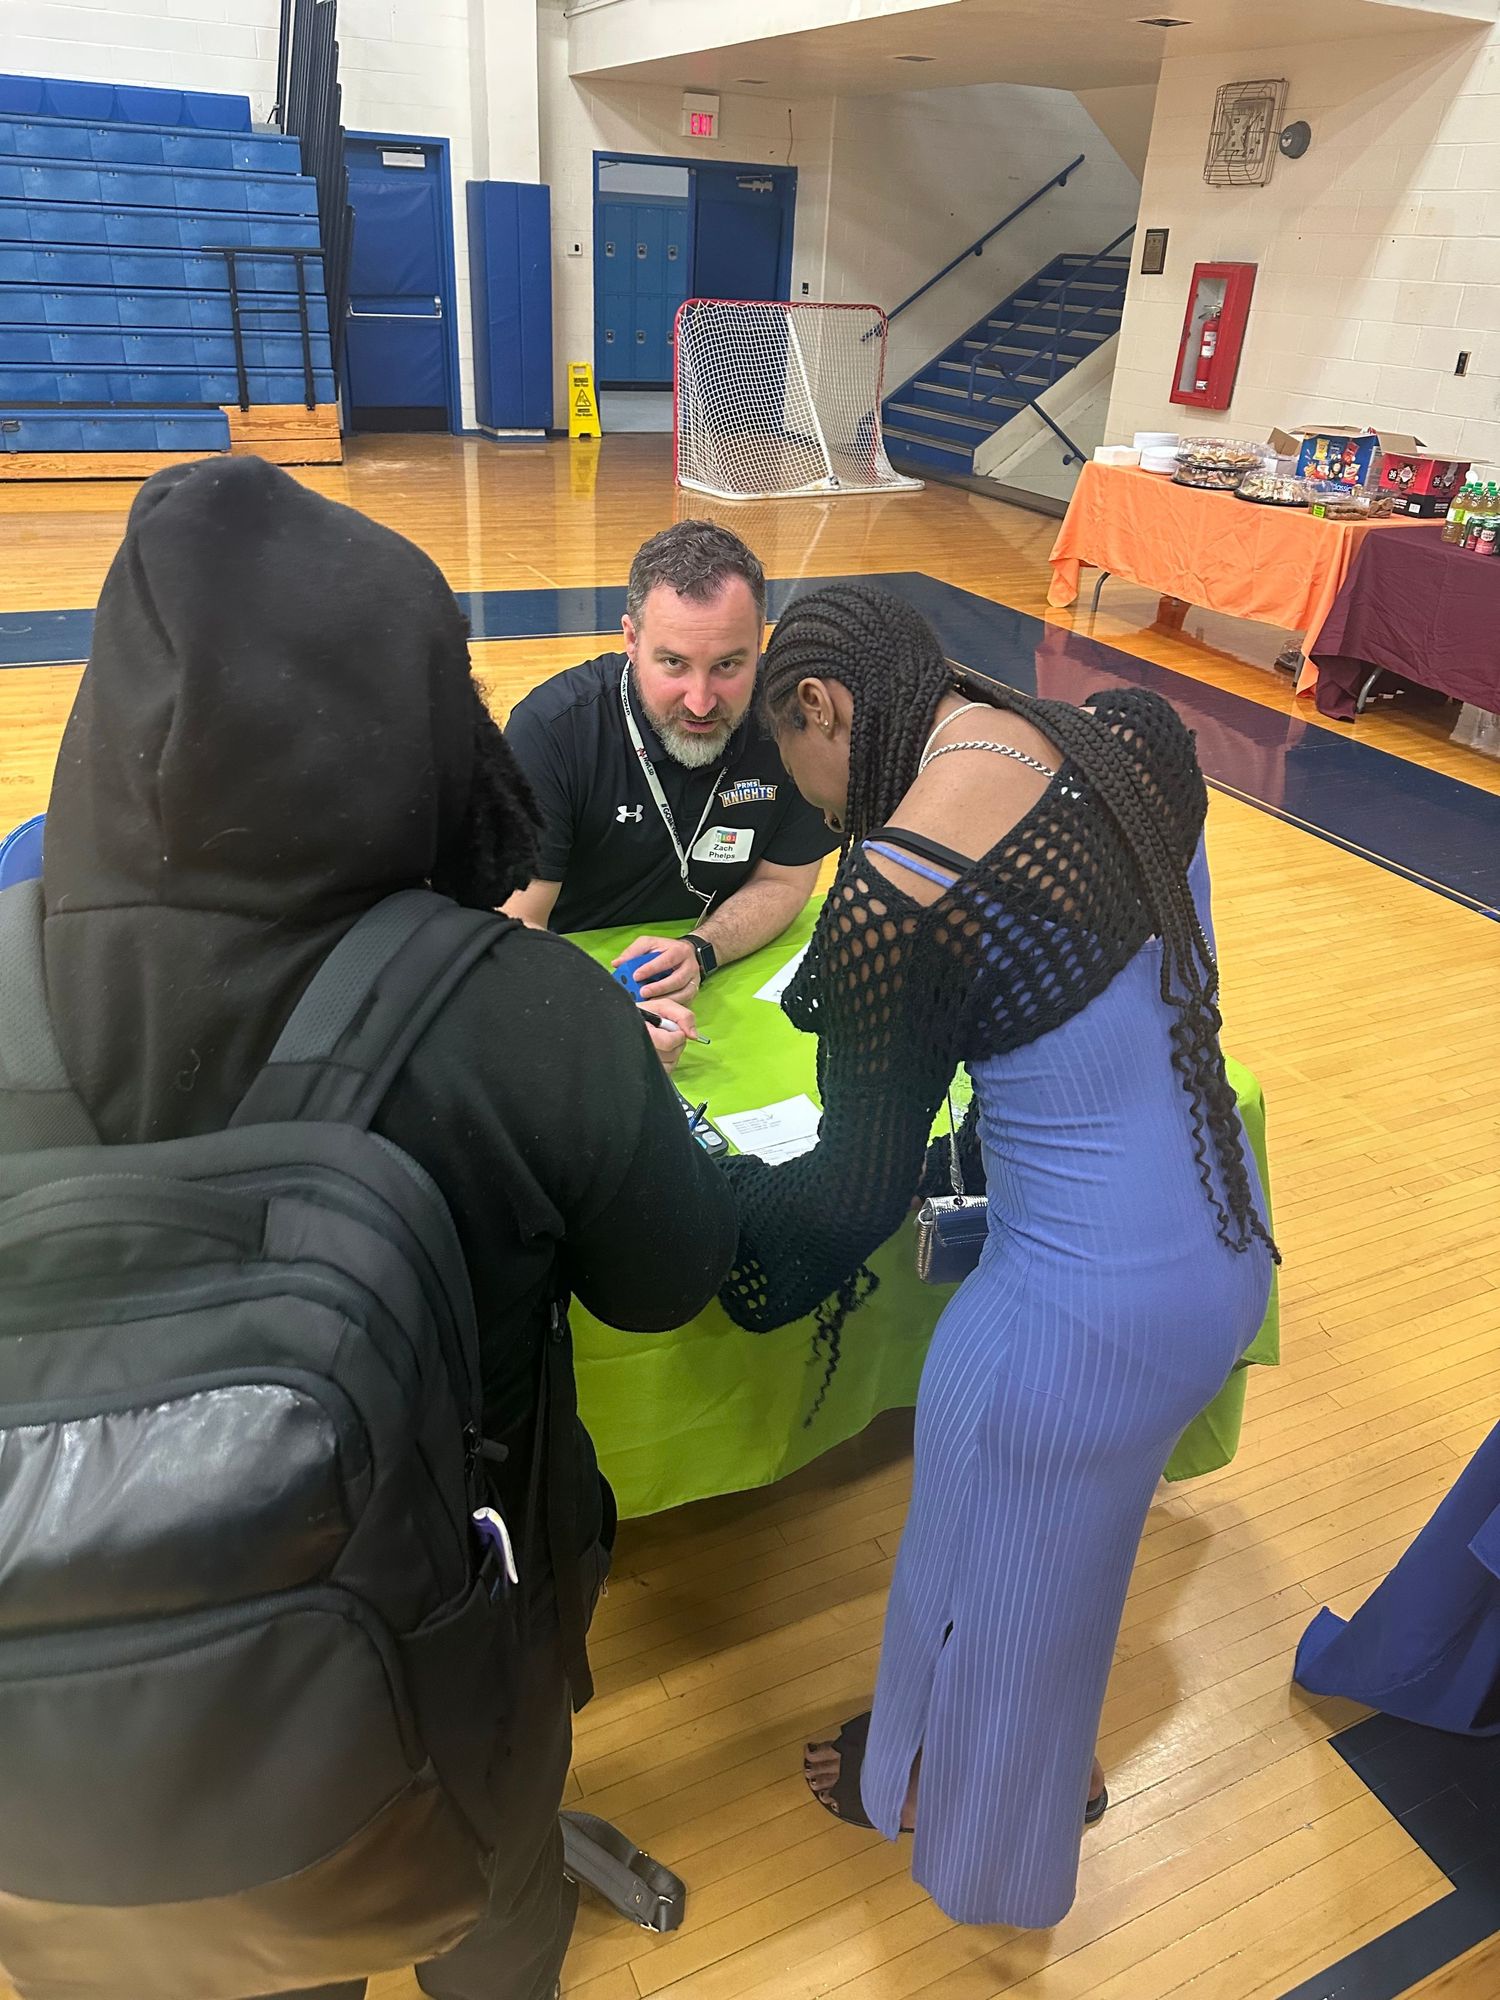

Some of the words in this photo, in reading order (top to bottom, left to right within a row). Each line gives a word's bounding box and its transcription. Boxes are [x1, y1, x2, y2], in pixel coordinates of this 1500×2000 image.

[691, 112, 713, 136] EXIT
[736, 781, 758, 789] PRMS
[723, 787, 774, 806] KNIGHTS
[713, 843, 733, 852] Zach
[709, 851, 736, 860] Phelps
